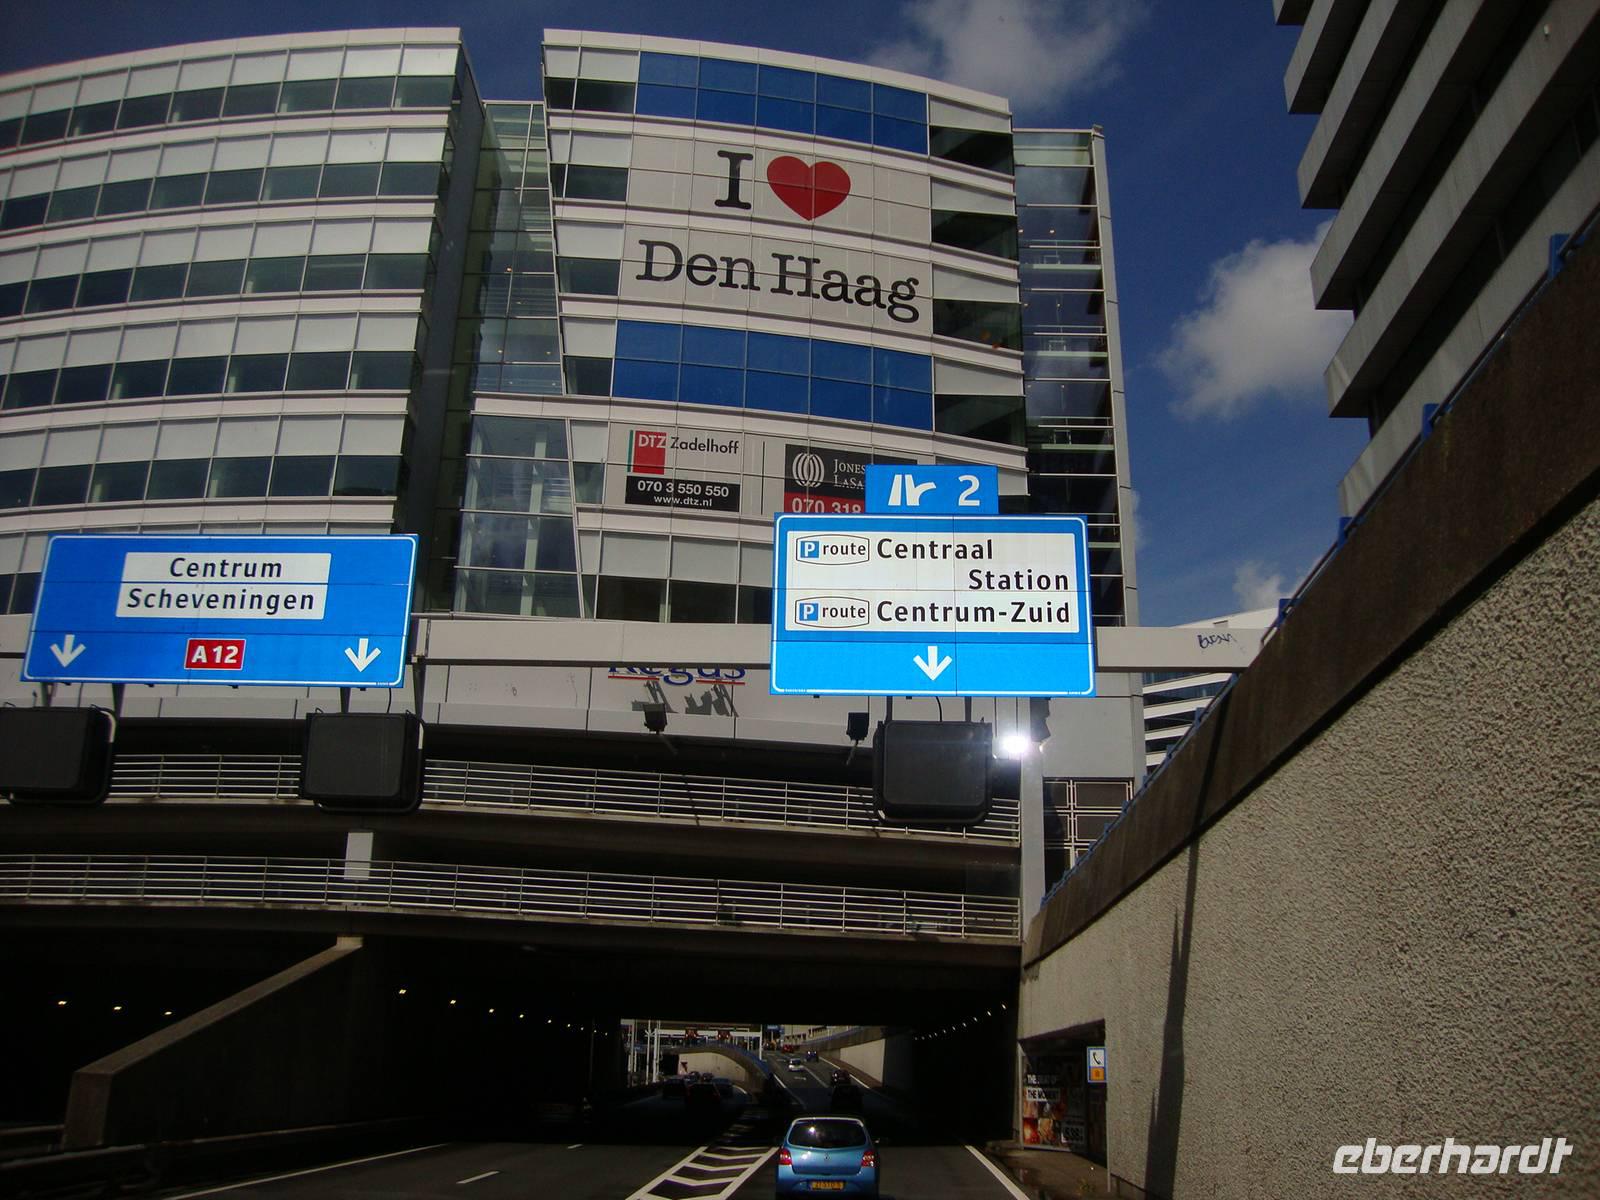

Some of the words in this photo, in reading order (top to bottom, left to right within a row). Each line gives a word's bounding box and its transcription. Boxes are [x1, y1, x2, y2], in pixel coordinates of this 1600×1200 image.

[714, 150, 754, 210] I
[635, 239, 761, 291] Den
[770, 252, 920, 323] Haag
[639, 434, 667, 449] DTZ
[670, 436, 739, 454] Zadelhoff
[637, 480, 663, 493] 070
[666, 482, 675, 493] 3
[678, 483, 702, 495] 550
[705, 485, 729, 497] 550
[958, 475, 981, 506] 2
[654, 496, 713, 507] www.dtz.nl
[792, 497, 825, 513] 070
[803, 542, 816, 557] P
[823, 542, 867, 557] route
[877, 538, 993, 560] Centraal
[170, 557, 283, 578] Centrum
[969, 569, 1070, 591] Station
[127, 587, 315, 615] Scheveningen
[803, 604, 816, 620] P
[822, 605, 867, 619] route
[877, 600, 1070, 623] Centrum-Zuid
